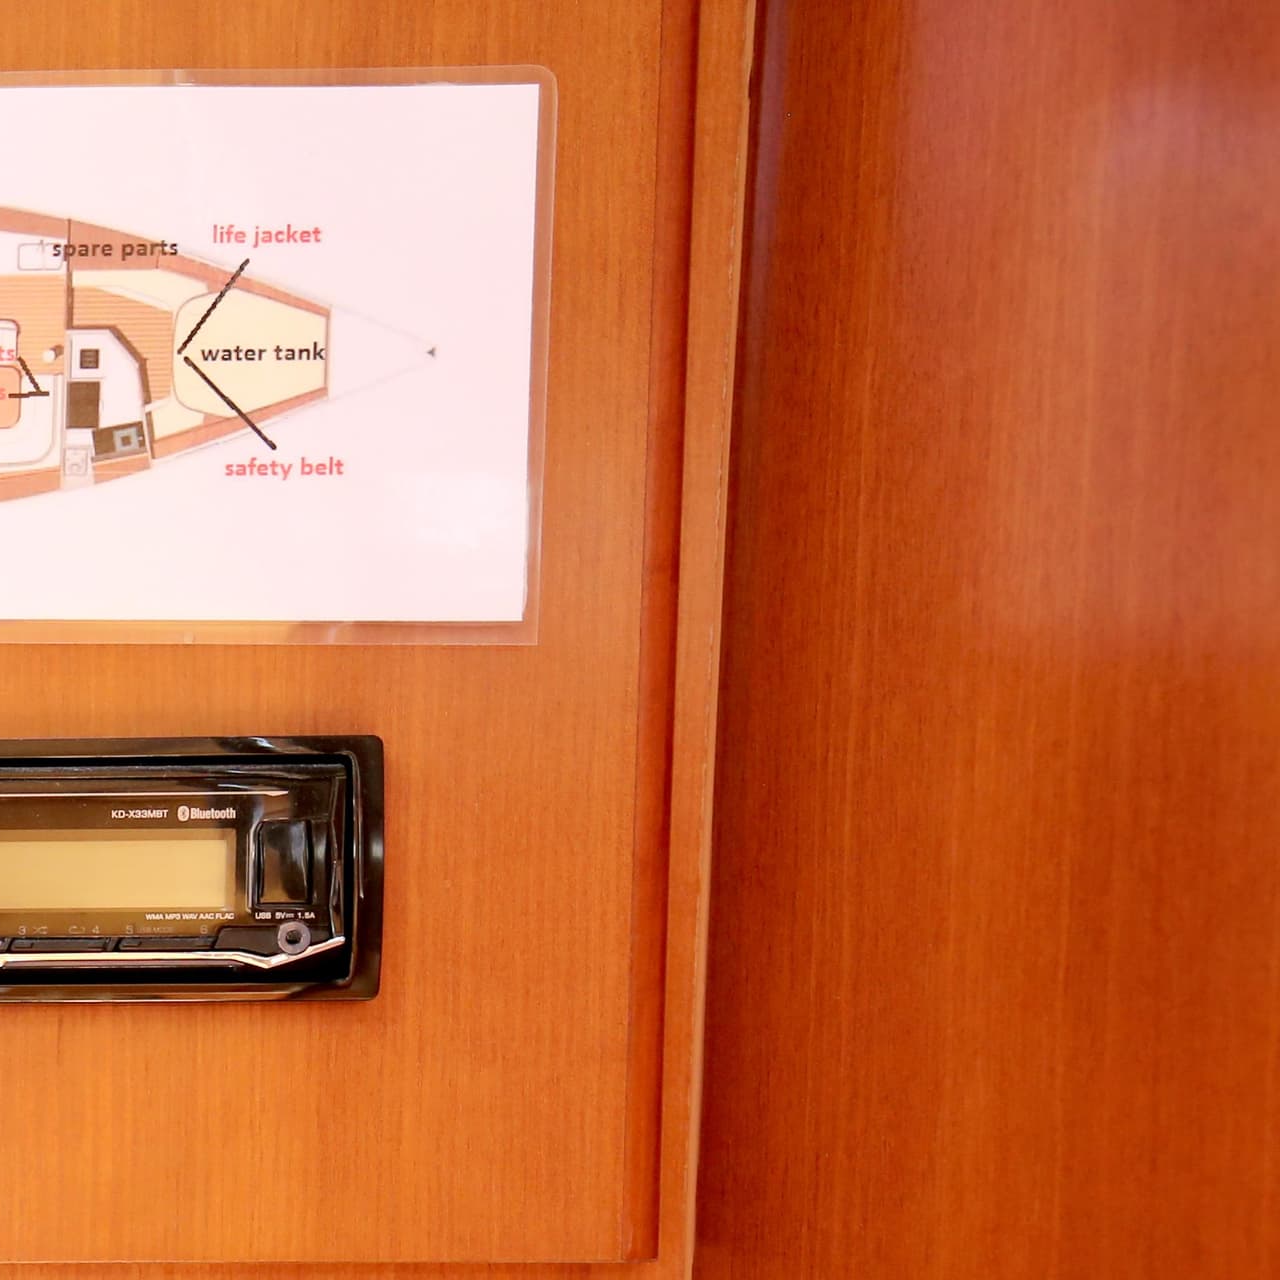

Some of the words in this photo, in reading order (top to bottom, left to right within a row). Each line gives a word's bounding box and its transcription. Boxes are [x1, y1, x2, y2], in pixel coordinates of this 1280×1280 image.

[212, 224, 246, 244] life
[253, 224, 322, 247] jacket
[52, 241, 114, 258] spare
[120, 239, 179, 258] parts
[201, 345, 267, 362] water
[274, 342, 326, 361] tank
[225, 457, 293, 481] safety
[300, 457, 345, 476] belt
[190, 806, 236, 820] Bluetooth
[165, 912, 181, 920] MP3
[182, 912, 199, 920] WAV
[199, 912, 214, 920] AAC
[215, 912, 235, 920] FLAC
[255, 912, 272, 920] USB
